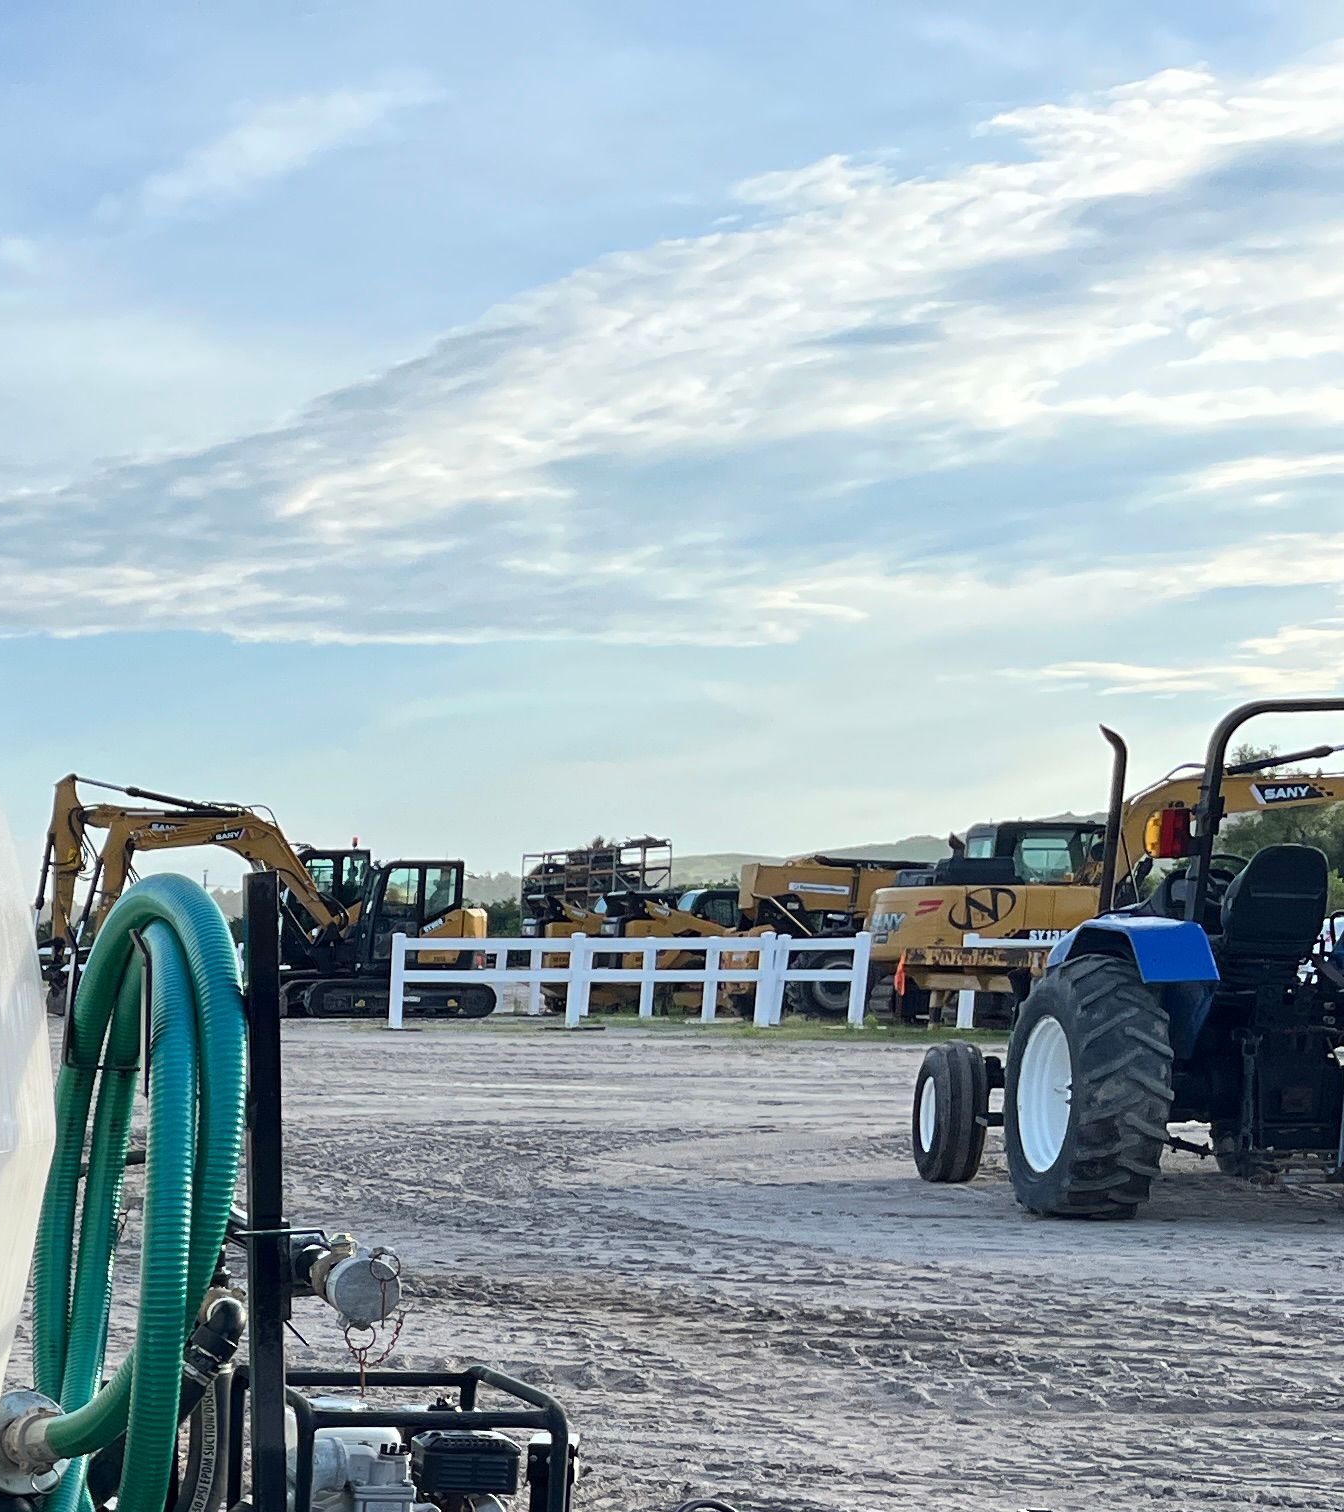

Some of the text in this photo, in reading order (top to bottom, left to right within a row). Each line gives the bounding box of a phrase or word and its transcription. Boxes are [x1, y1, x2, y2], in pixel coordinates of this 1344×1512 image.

[1264, 786, 1310, 800] SANY
[215, 831, 240, 841] SANY
[200, 1457, 214, 1486] EPDM
[196, 1485, 209, 1502] PSI
